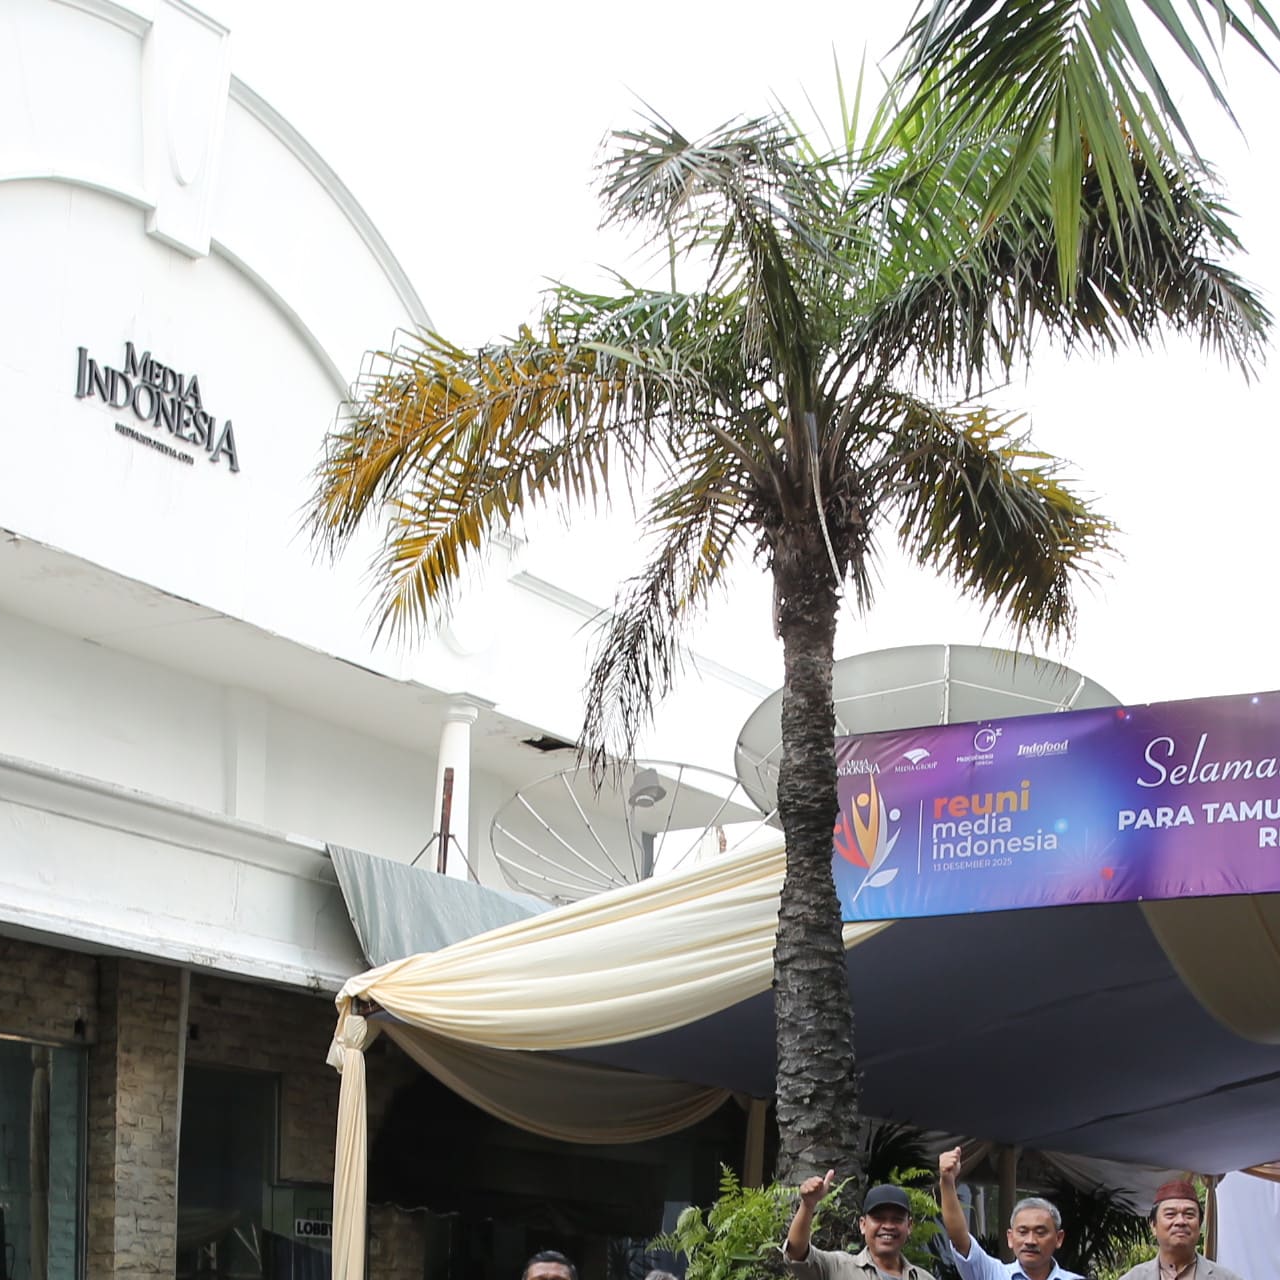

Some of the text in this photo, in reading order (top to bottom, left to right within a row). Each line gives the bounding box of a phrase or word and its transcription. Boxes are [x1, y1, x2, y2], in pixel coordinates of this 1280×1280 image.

[124, 341, 203, 410] MEDIA
[75, 346, 240, 474] INDONESIA
[1017, 739, 1069, 757] Indofood
[836, 763, 880, 777] NDONESIA
[933, 780, 1031, 819] reuni
[932, 812, 1012, 839] media
[1118, 807, 1194, 832] PARA
[932, 828, 1058, 860] indonesia
[943, 859, 990, 872] DESEMBER
